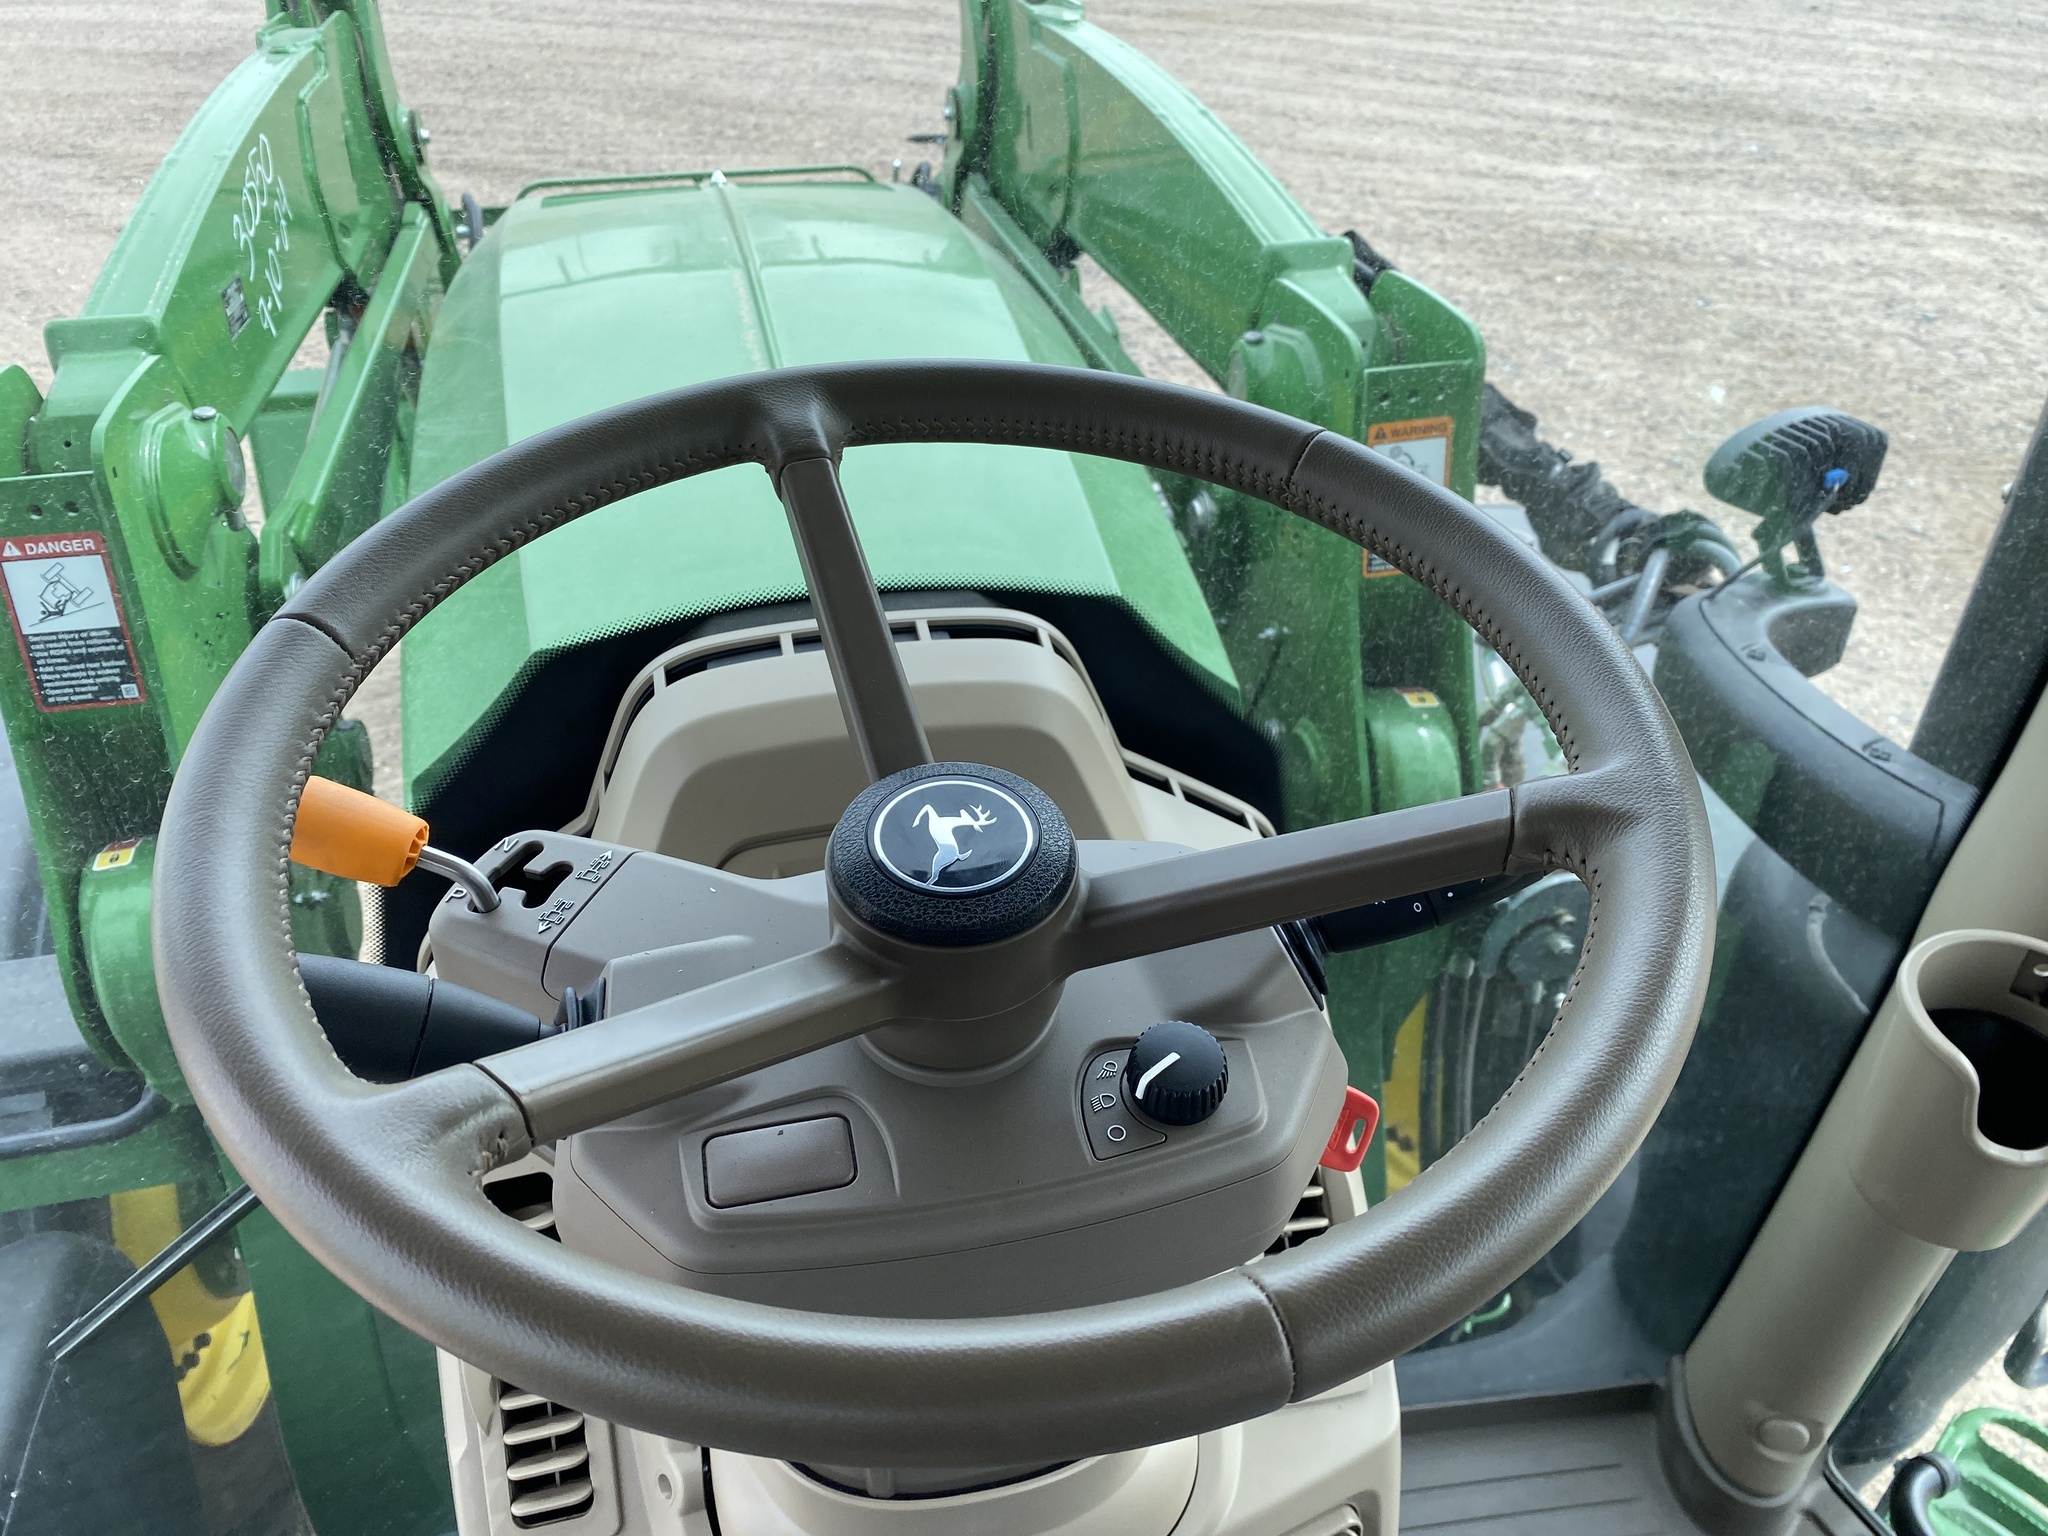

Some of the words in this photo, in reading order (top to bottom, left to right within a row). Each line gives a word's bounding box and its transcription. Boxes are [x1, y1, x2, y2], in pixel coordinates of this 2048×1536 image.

[1390, 422, 1448, 438] WARNING
[24, 538, 96, 556] DANGER
[28, 634, 57, 643] Serious
[58, 632, 78, 640] injury
[80, 630, 88, 638] or
[67, 639, 85, 647] from
[49, 648, 71, 656] ROPS
[72, 646, 87, 654] and
[45, 687, 74, 696] Operate
[74, 684, 99, 693] tractor
[494, 836, 519, 852] N
[444, 887, 467, 903] P
